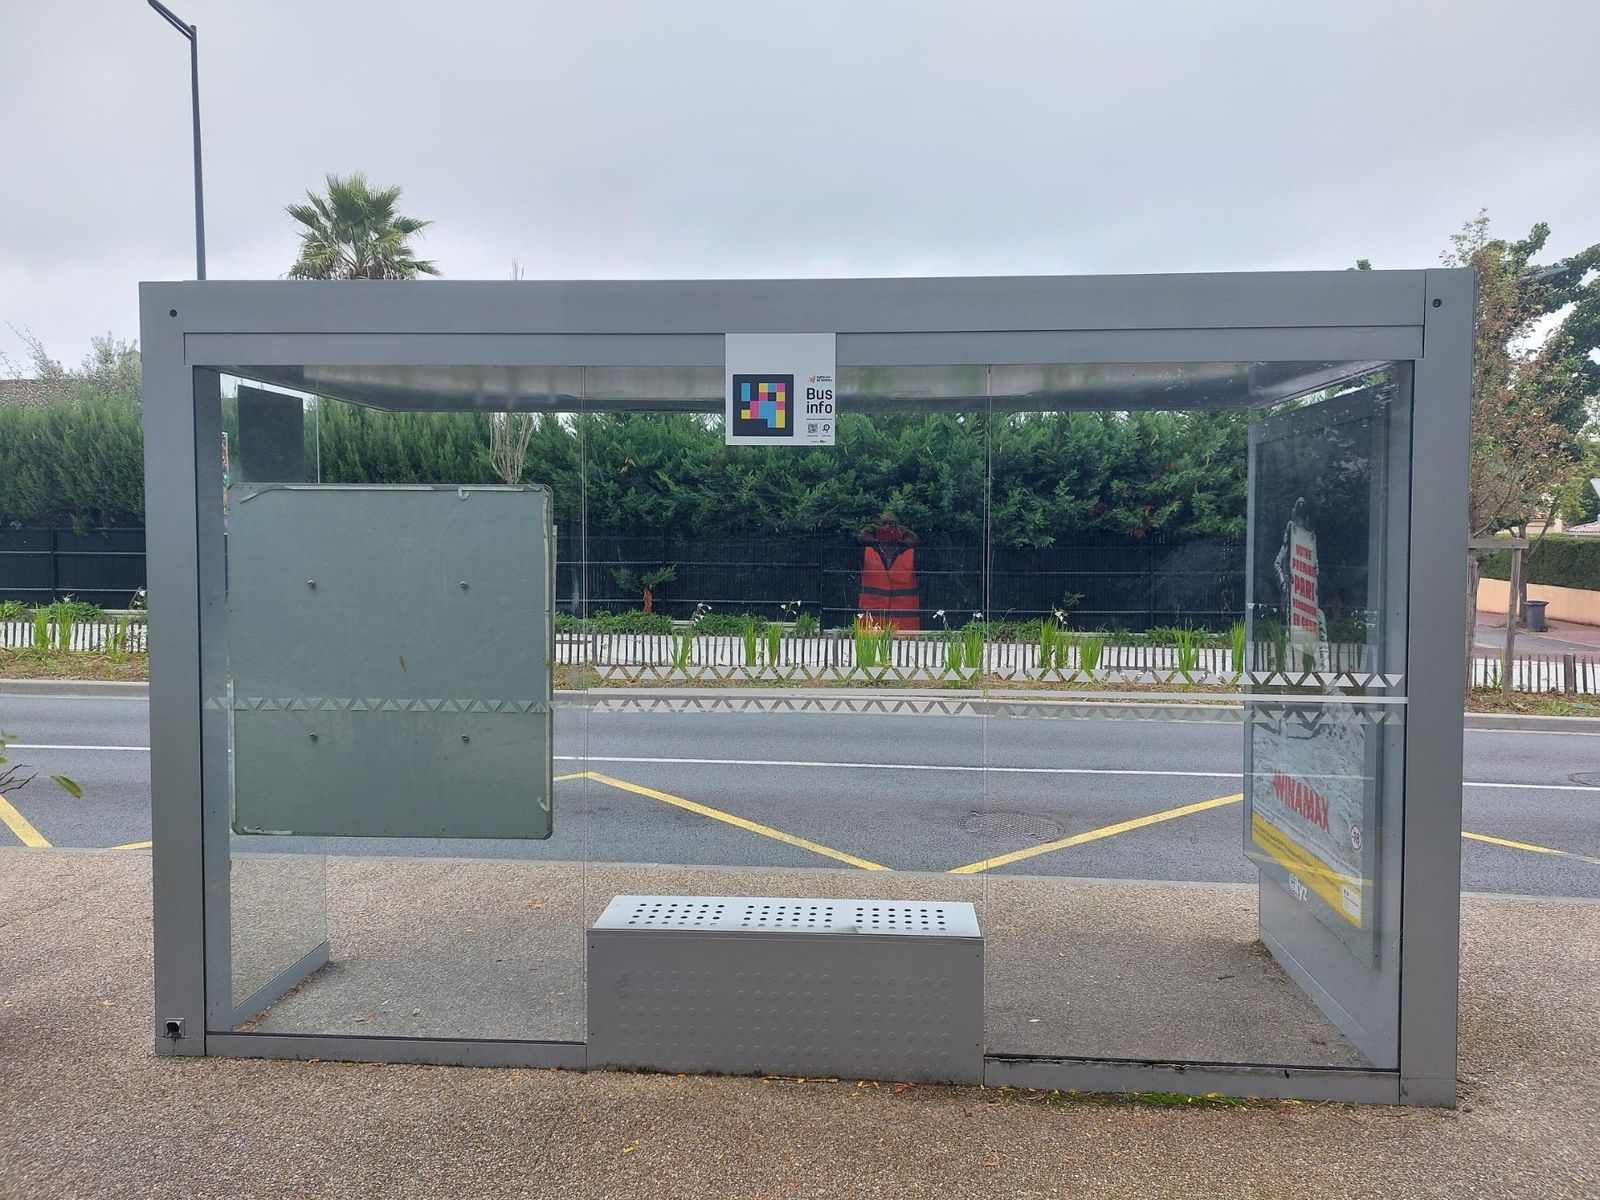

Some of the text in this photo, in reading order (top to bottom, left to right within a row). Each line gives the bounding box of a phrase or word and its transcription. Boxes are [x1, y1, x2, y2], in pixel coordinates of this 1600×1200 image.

[806, 387, 833, 400] Bus
[806, 401, 833, 414] info
[1294, 574, 1315, 602] PARI
[1293, 612, 1301, 627] EN
[1273, 768, 1329, 832] WINAMAX
